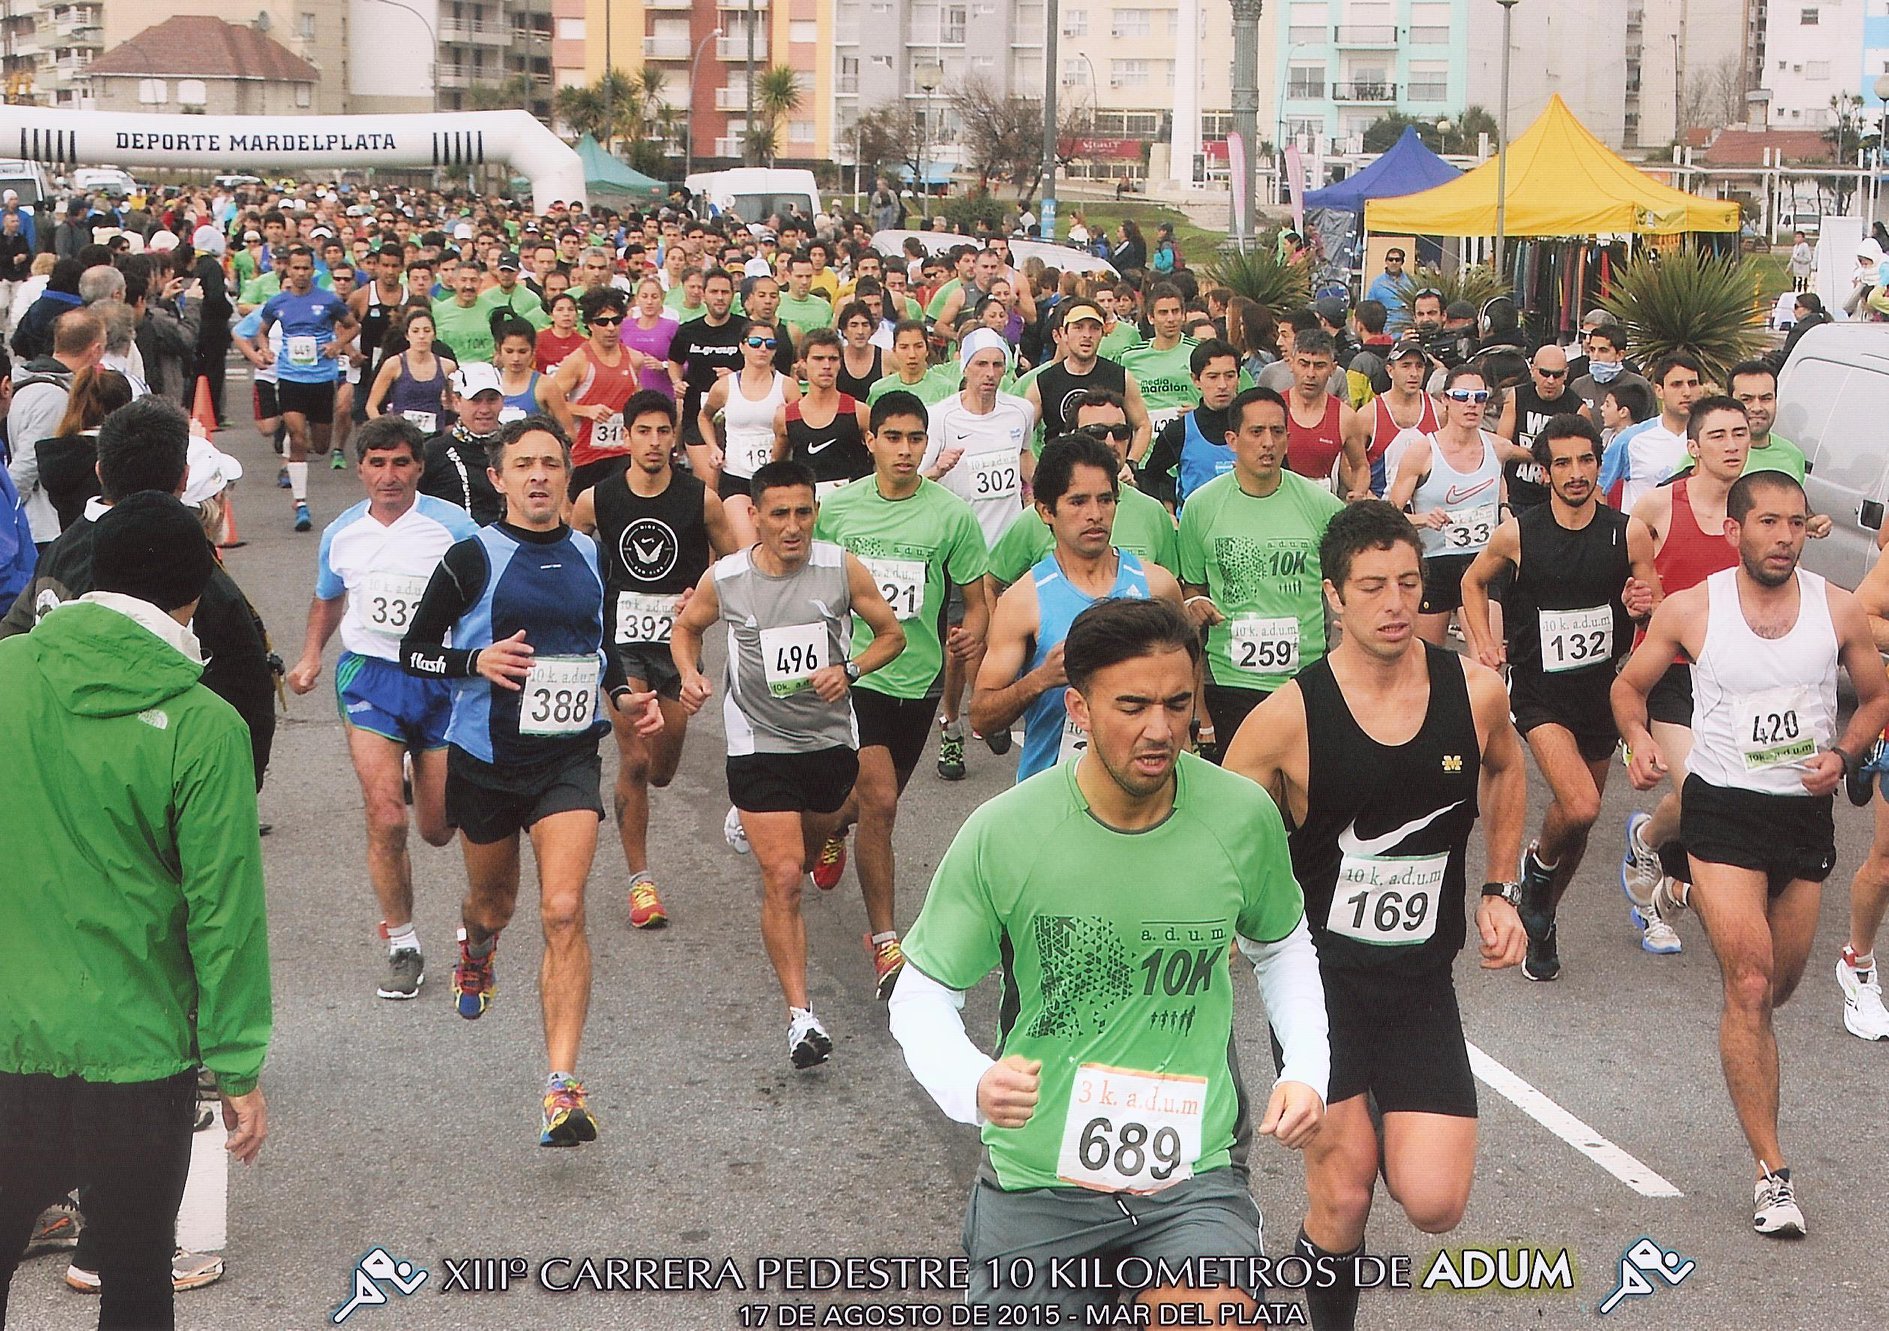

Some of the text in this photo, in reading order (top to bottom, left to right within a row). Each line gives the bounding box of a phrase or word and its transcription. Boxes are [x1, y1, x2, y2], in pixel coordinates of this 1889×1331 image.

[116, 132, 397, 151] DEPORTE MARDELPLATA
[1141, 378, 1169, 386] media
[1141, 382, 1188, 393] maratón
[746, 449, 773, 467] 18
[976, 467, 1015, 493] 302
[1453, 523, 1490, 547] 33
[1269, 551, 1308, 576] 10K
[623, 614, 674, 641] 392
[776, 643, 818, 675] 496
[1239, 640, 1292, 668] 259
[1550, 630, 1606, 662] 132
[410, 652, 447, 674] flash
[531, 688, 589, 723] 388
[1752, 709, 1800, 745] 420
[1346, 866, 1442, 886] 10 k. a.d.u.m
[1347, 890, 1429, 932] 169
[1140, 946, 1224, 996] 10K
[1078, 1080, 1199, 1116] 3 k. a.d.u.m
[1078, 1116, 1181, 1180] 689
